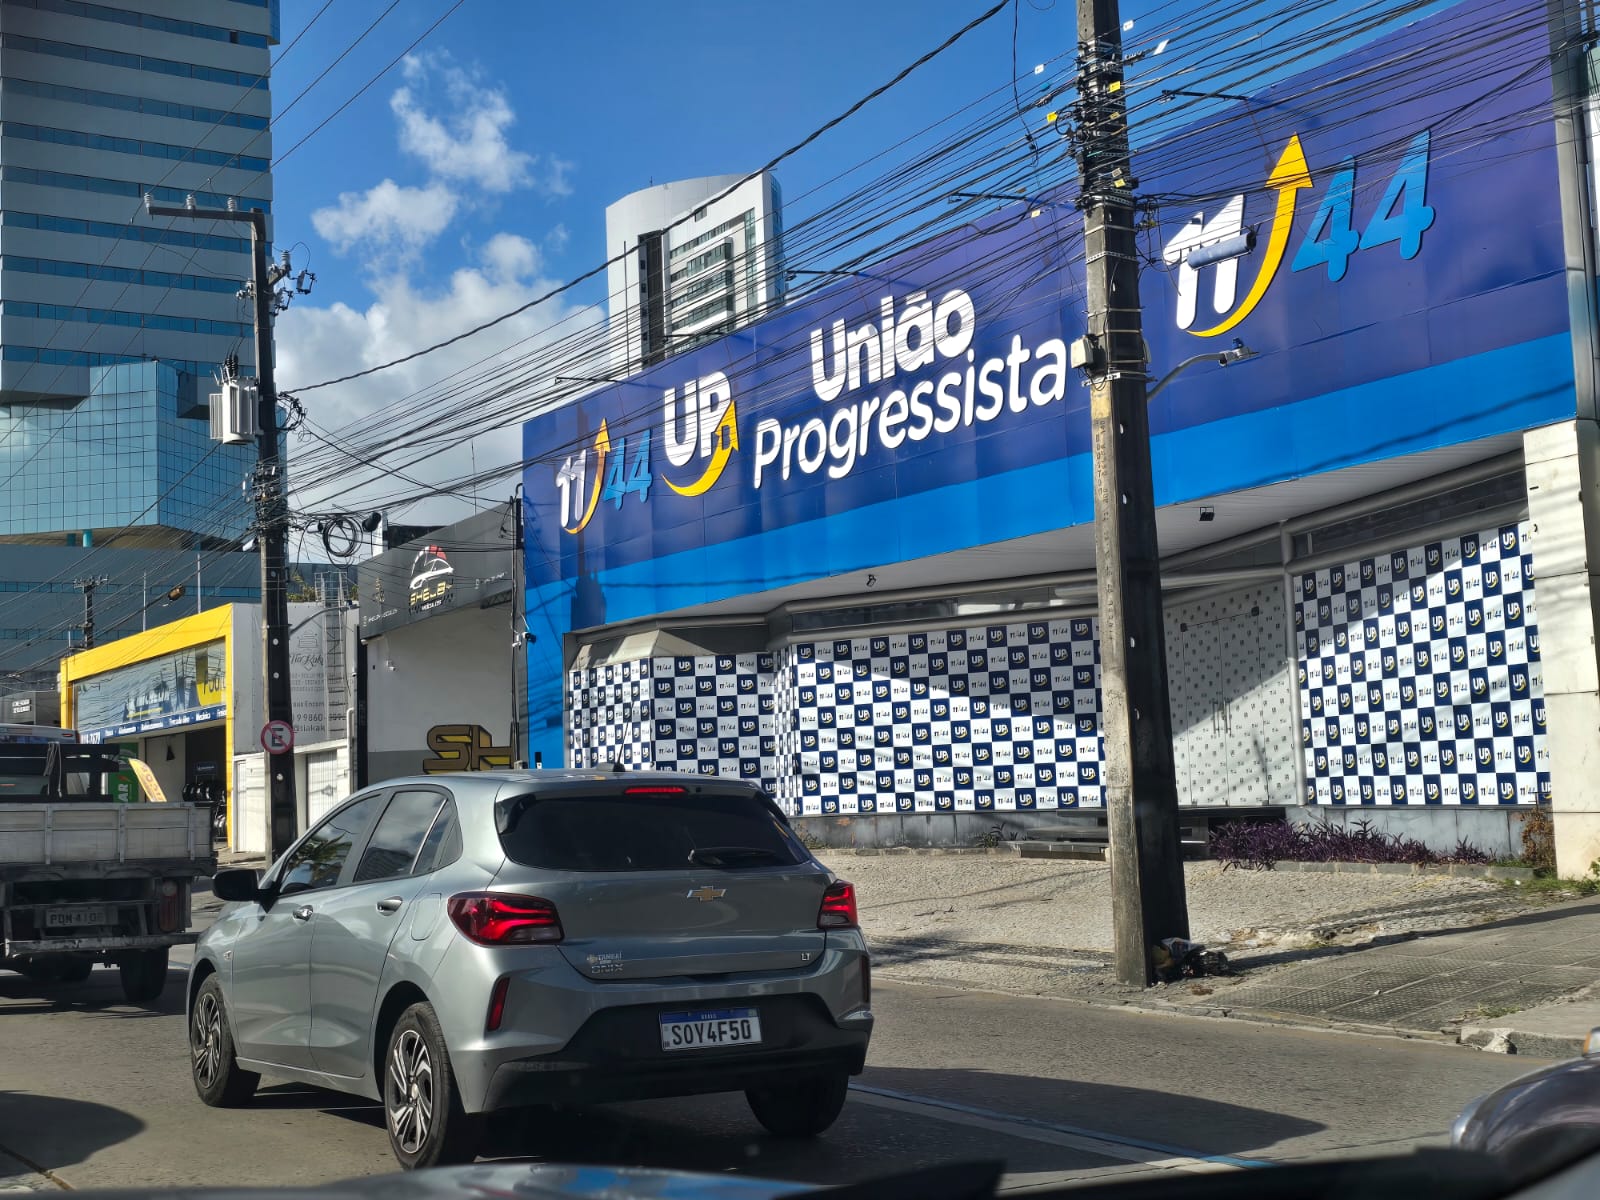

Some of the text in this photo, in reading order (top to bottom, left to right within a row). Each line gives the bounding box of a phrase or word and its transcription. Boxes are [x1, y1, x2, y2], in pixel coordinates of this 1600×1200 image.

[810, 289, 976, 402] União
[663, 370, 734, 467] UP
[754, 334, 1067, 489] Progressista
